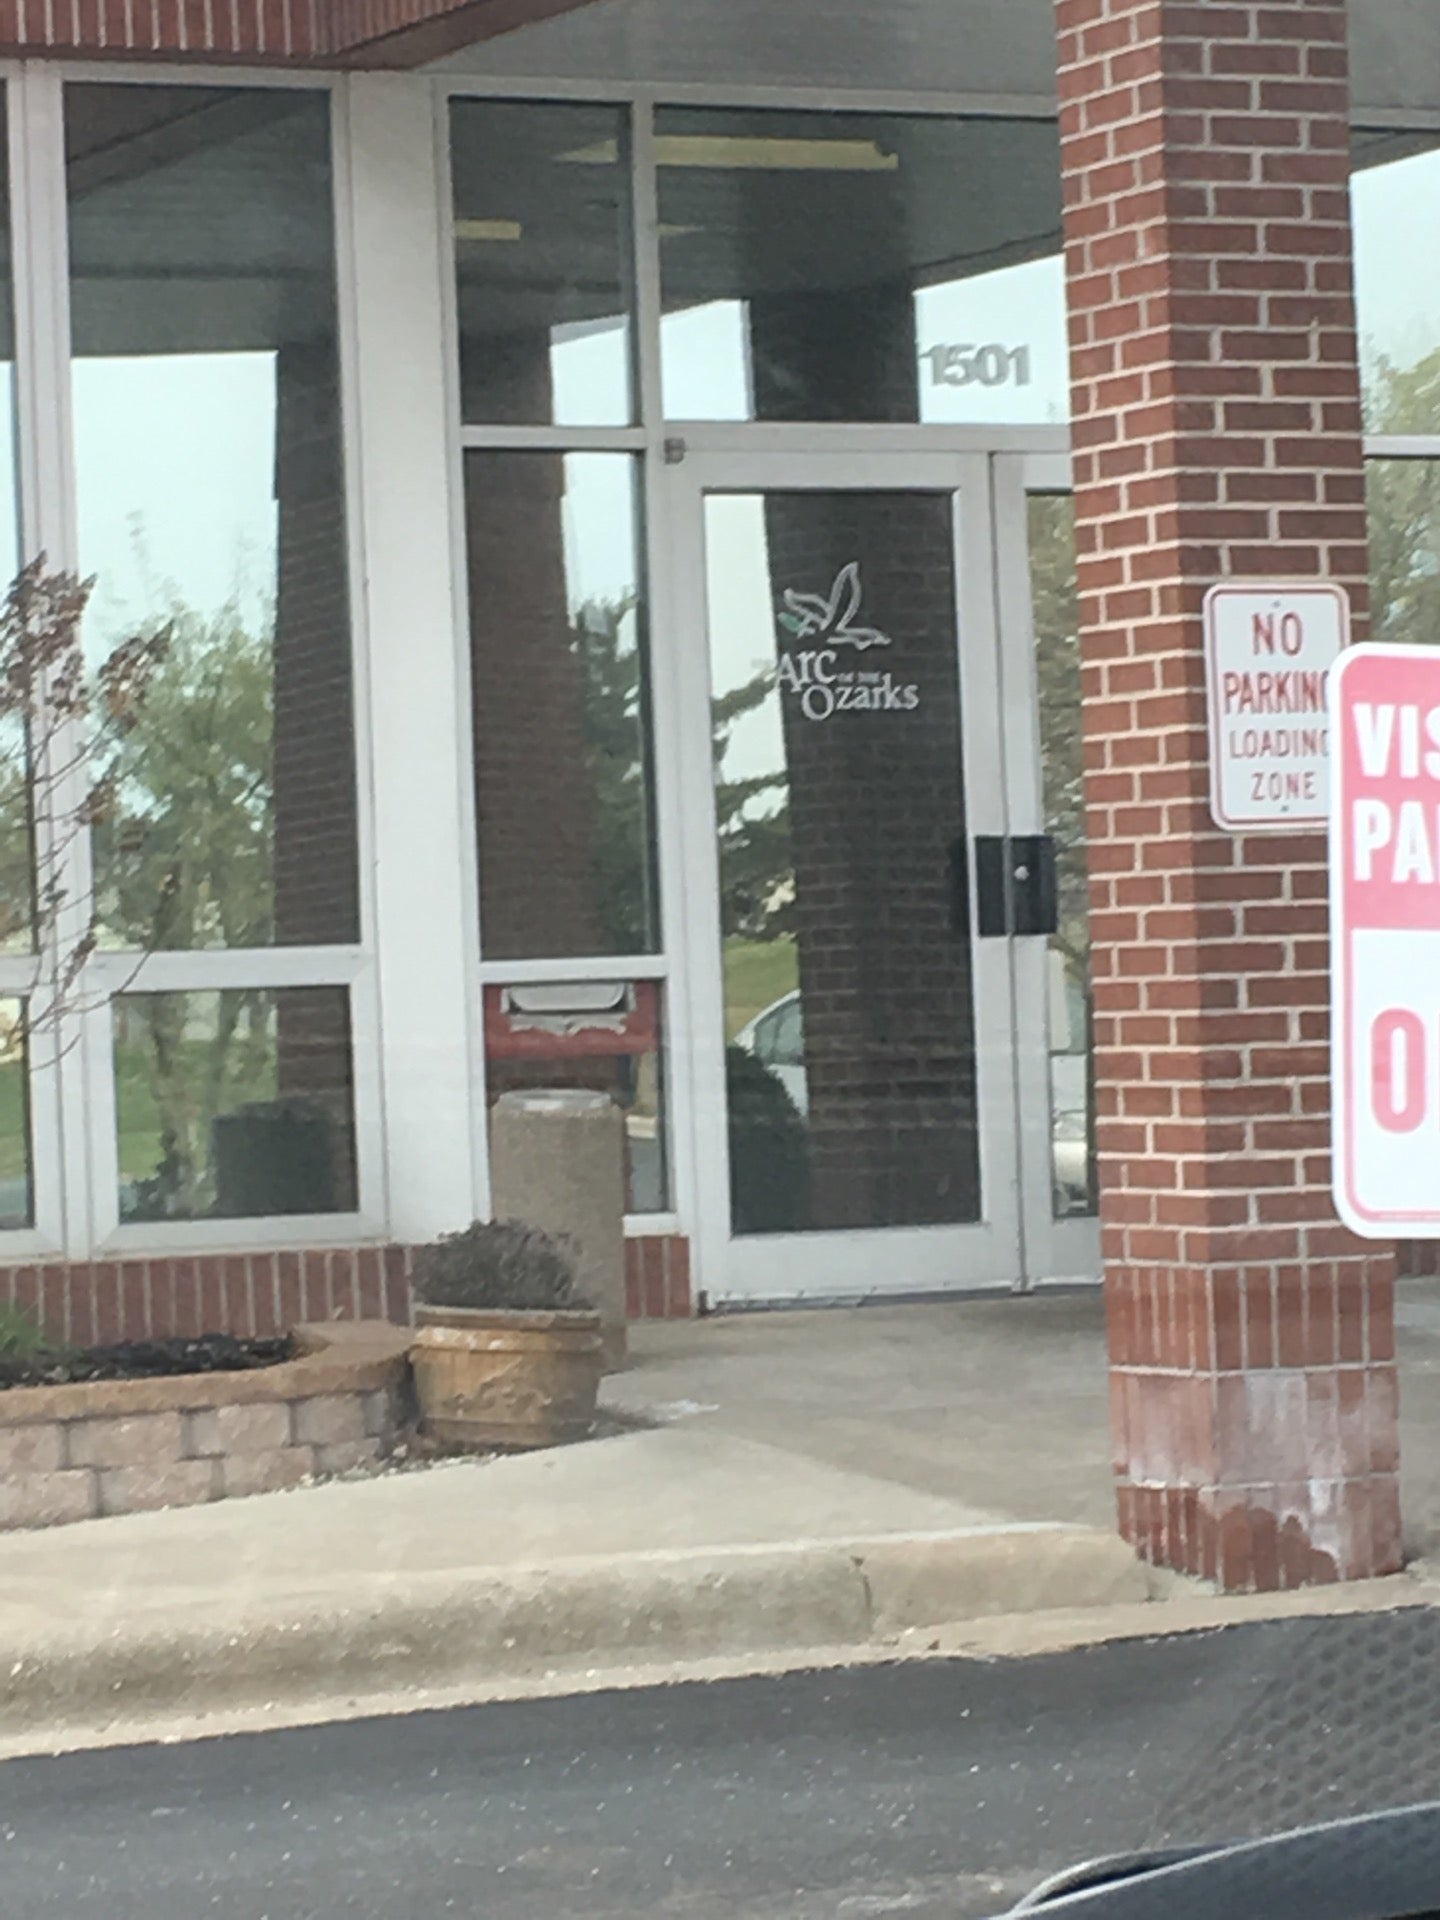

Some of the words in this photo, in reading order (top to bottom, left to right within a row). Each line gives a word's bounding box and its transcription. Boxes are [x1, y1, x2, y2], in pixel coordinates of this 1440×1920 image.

[919, 343, 1030, 387] 1501
[1253, 612, 1303, 656] NO
[775, 650, 837, 693] Arc
[801, 672, 919, 721] Ozarks
[1252, 772, 1317, 800] ZONE
[1353, 799, 1440, 884] PA
[1371, 1008, 1440, 1134] O
